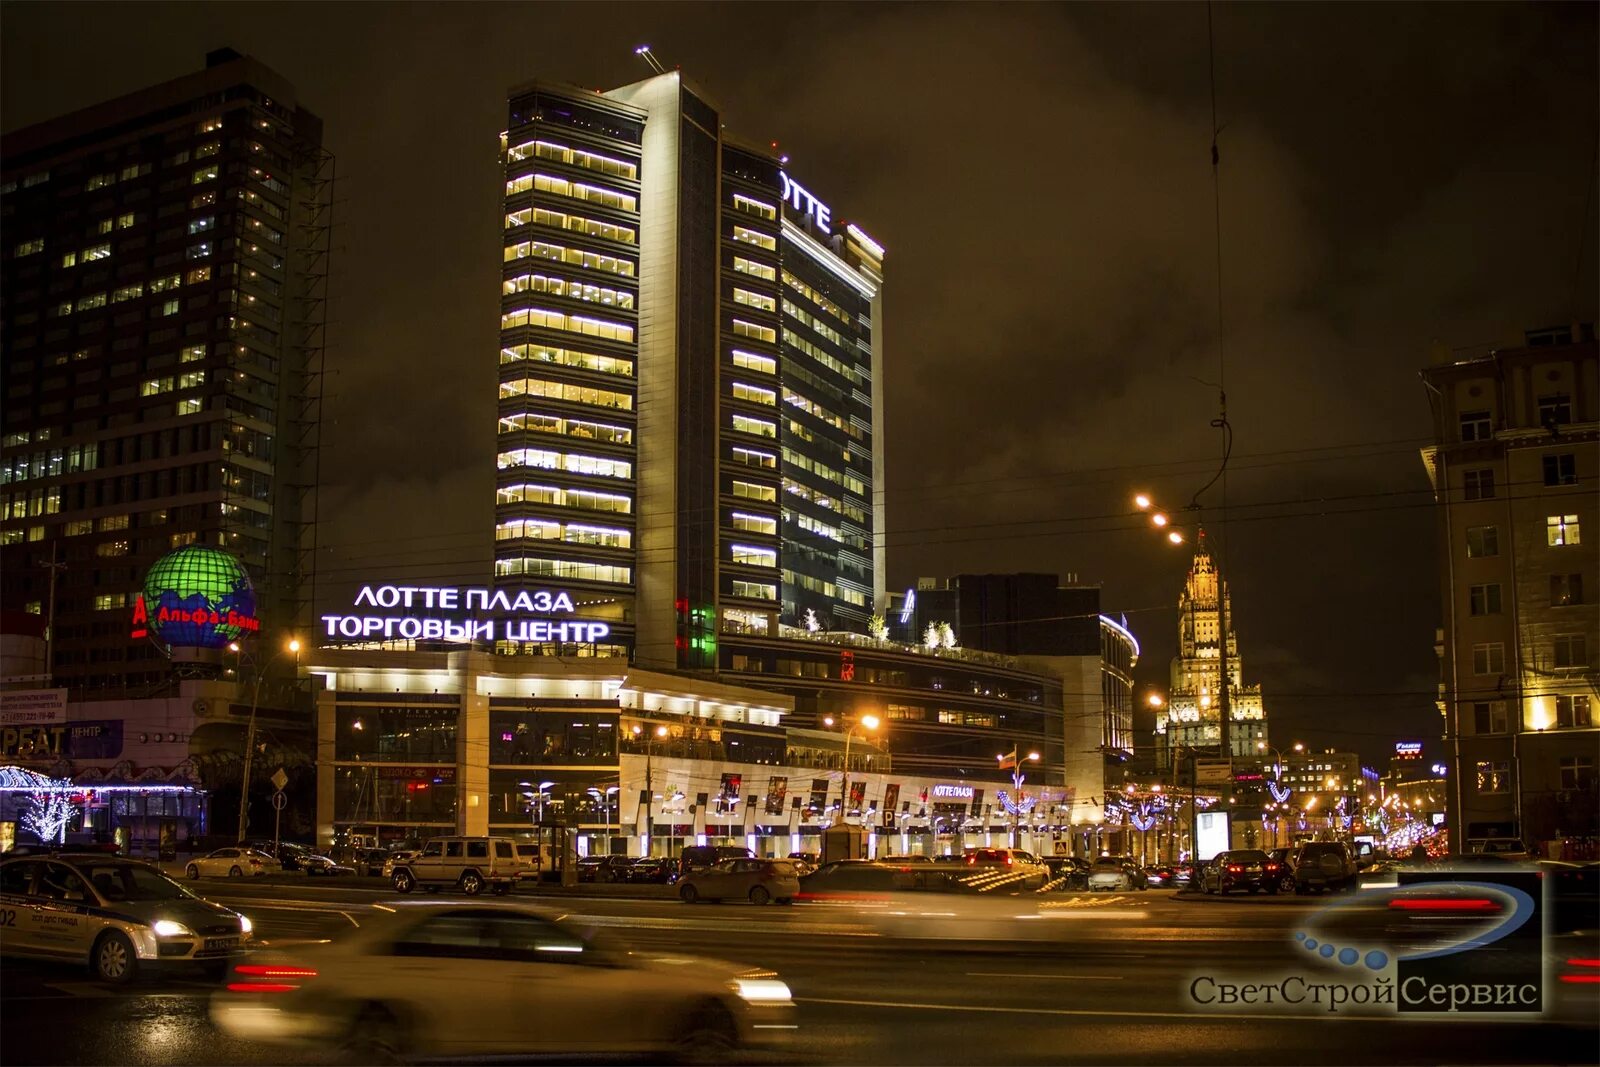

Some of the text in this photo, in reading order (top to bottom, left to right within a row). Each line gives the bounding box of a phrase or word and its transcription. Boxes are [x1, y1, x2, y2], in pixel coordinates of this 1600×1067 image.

[354, 586, 574, 612] ЛОТТЕ ПЛАЗА
[506, 621, 609, 642] ЦЕНТР
[71, 726, 101, 738] ЦЕНТР
